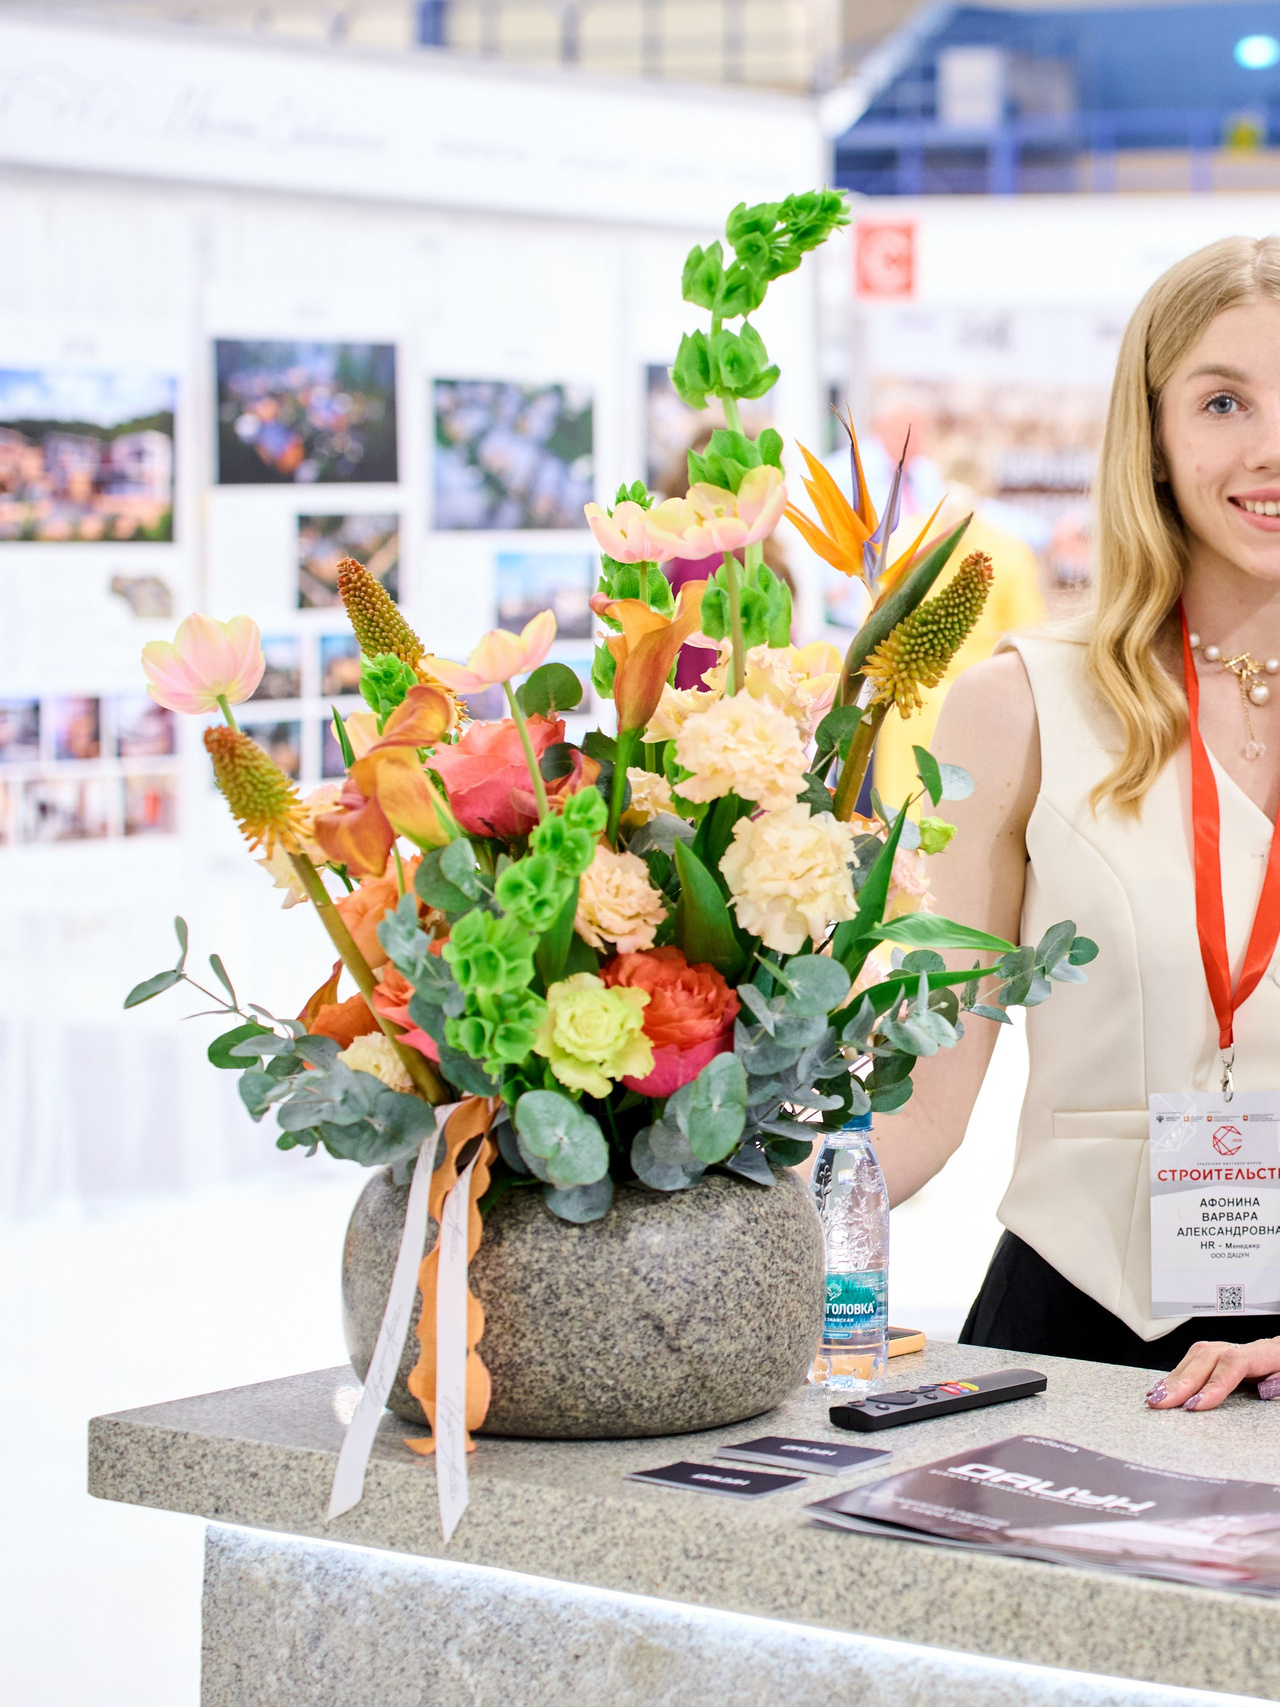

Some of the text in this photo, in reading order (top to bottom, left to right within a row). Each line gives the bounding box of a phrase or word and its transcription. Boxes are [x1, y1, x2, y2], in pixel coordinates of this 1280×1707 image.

[1199, 1197, 1261, 1208] АФОНИНА
[1201, 1211, 1259, 1222] ВАРВАРА
[1200, 1241, 1215, 1250] HR
[1225, 1242, 1261, 1250] Менеджер
[825, 1302, 874, 1315] ГОЛОВКА
